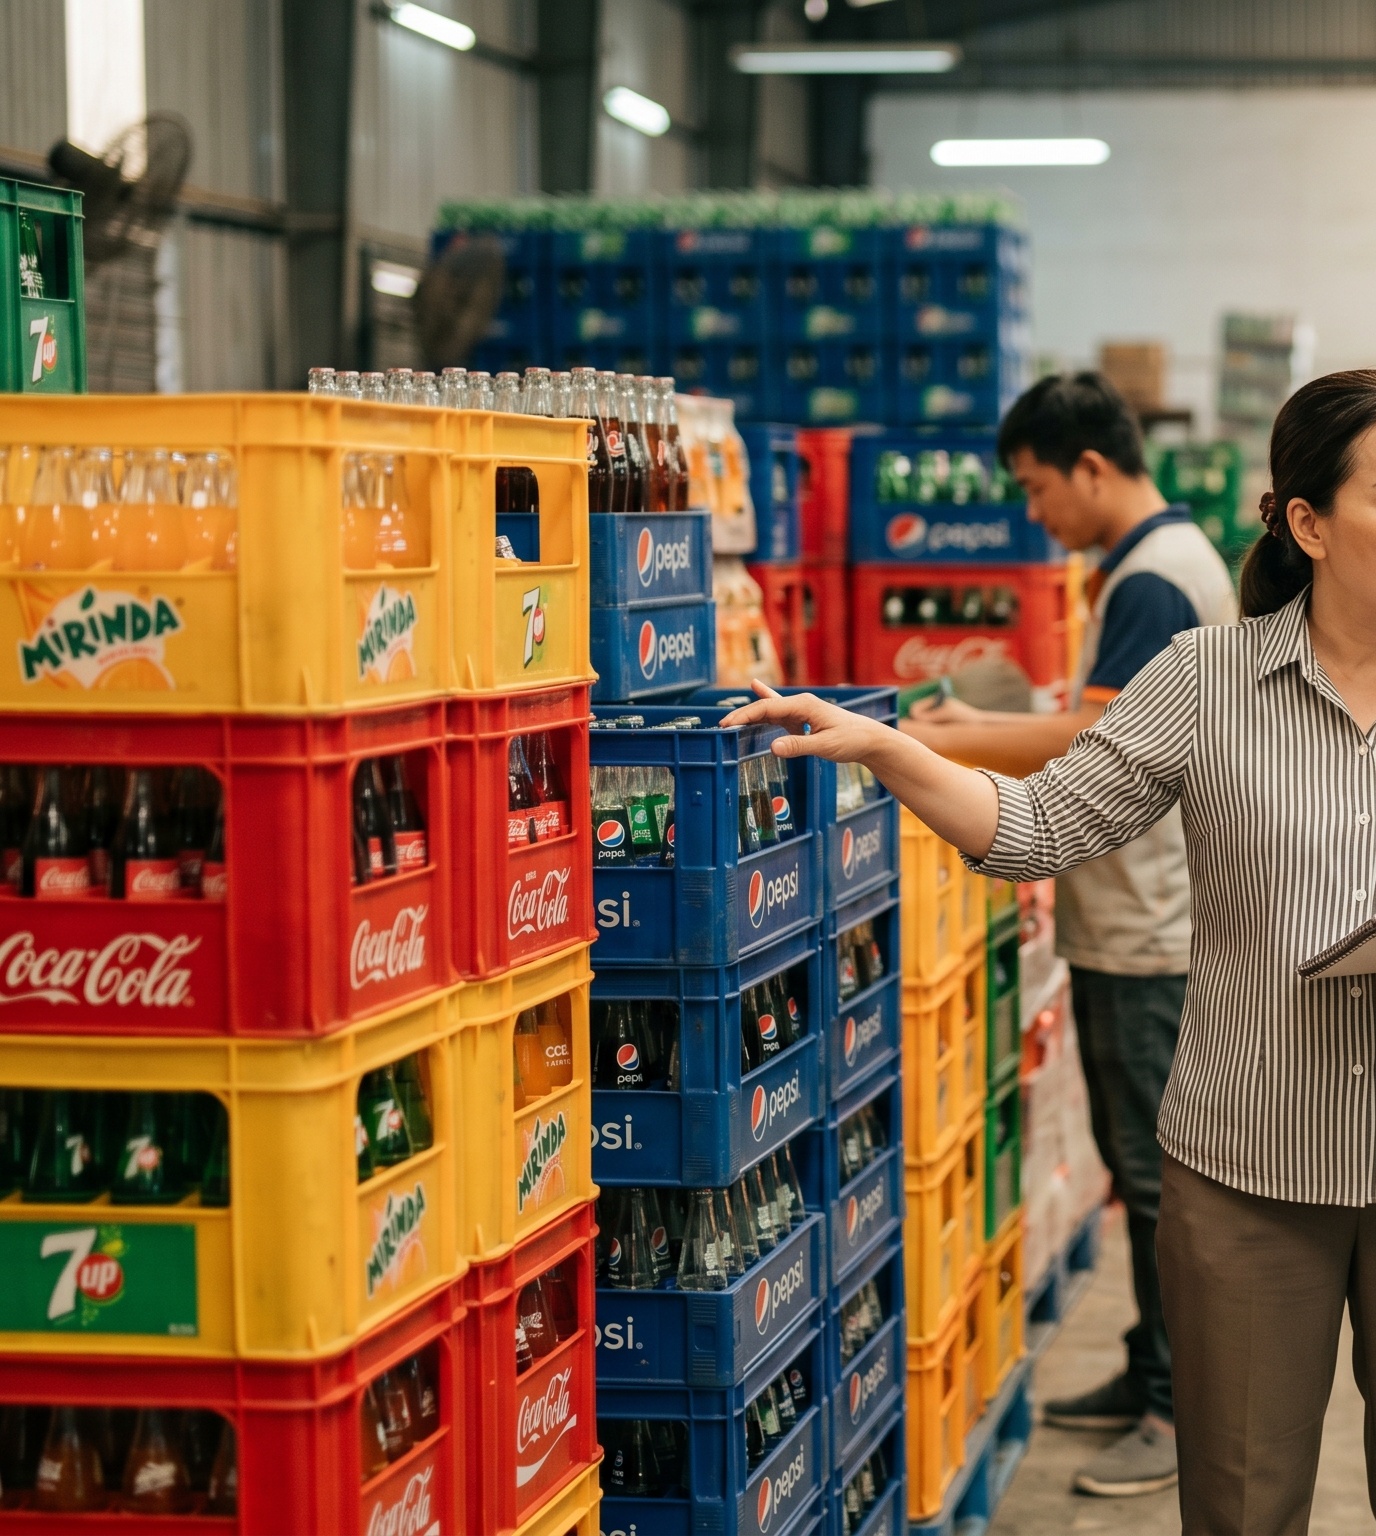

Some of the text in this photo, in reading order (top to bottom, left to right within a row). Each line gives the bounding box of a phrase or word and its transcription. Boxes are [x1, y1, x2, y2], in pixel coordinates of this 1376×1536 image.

[655, 534, 690, 581] pepsi
[659, 624, 695, 670] pepsi
[507, 866, 572, 941] Coca-Cola
[766, 862, 799, 915] pepsi
[350, 903, 429, 990] Coca-Cola
[768, 1068, 800, 1127] pepsi
[771, 1251, 804, 1319] pepsi
[517, 1366, 573, 1454] Coca-Cola
[773, 1443, 806, 1515] pepsi
